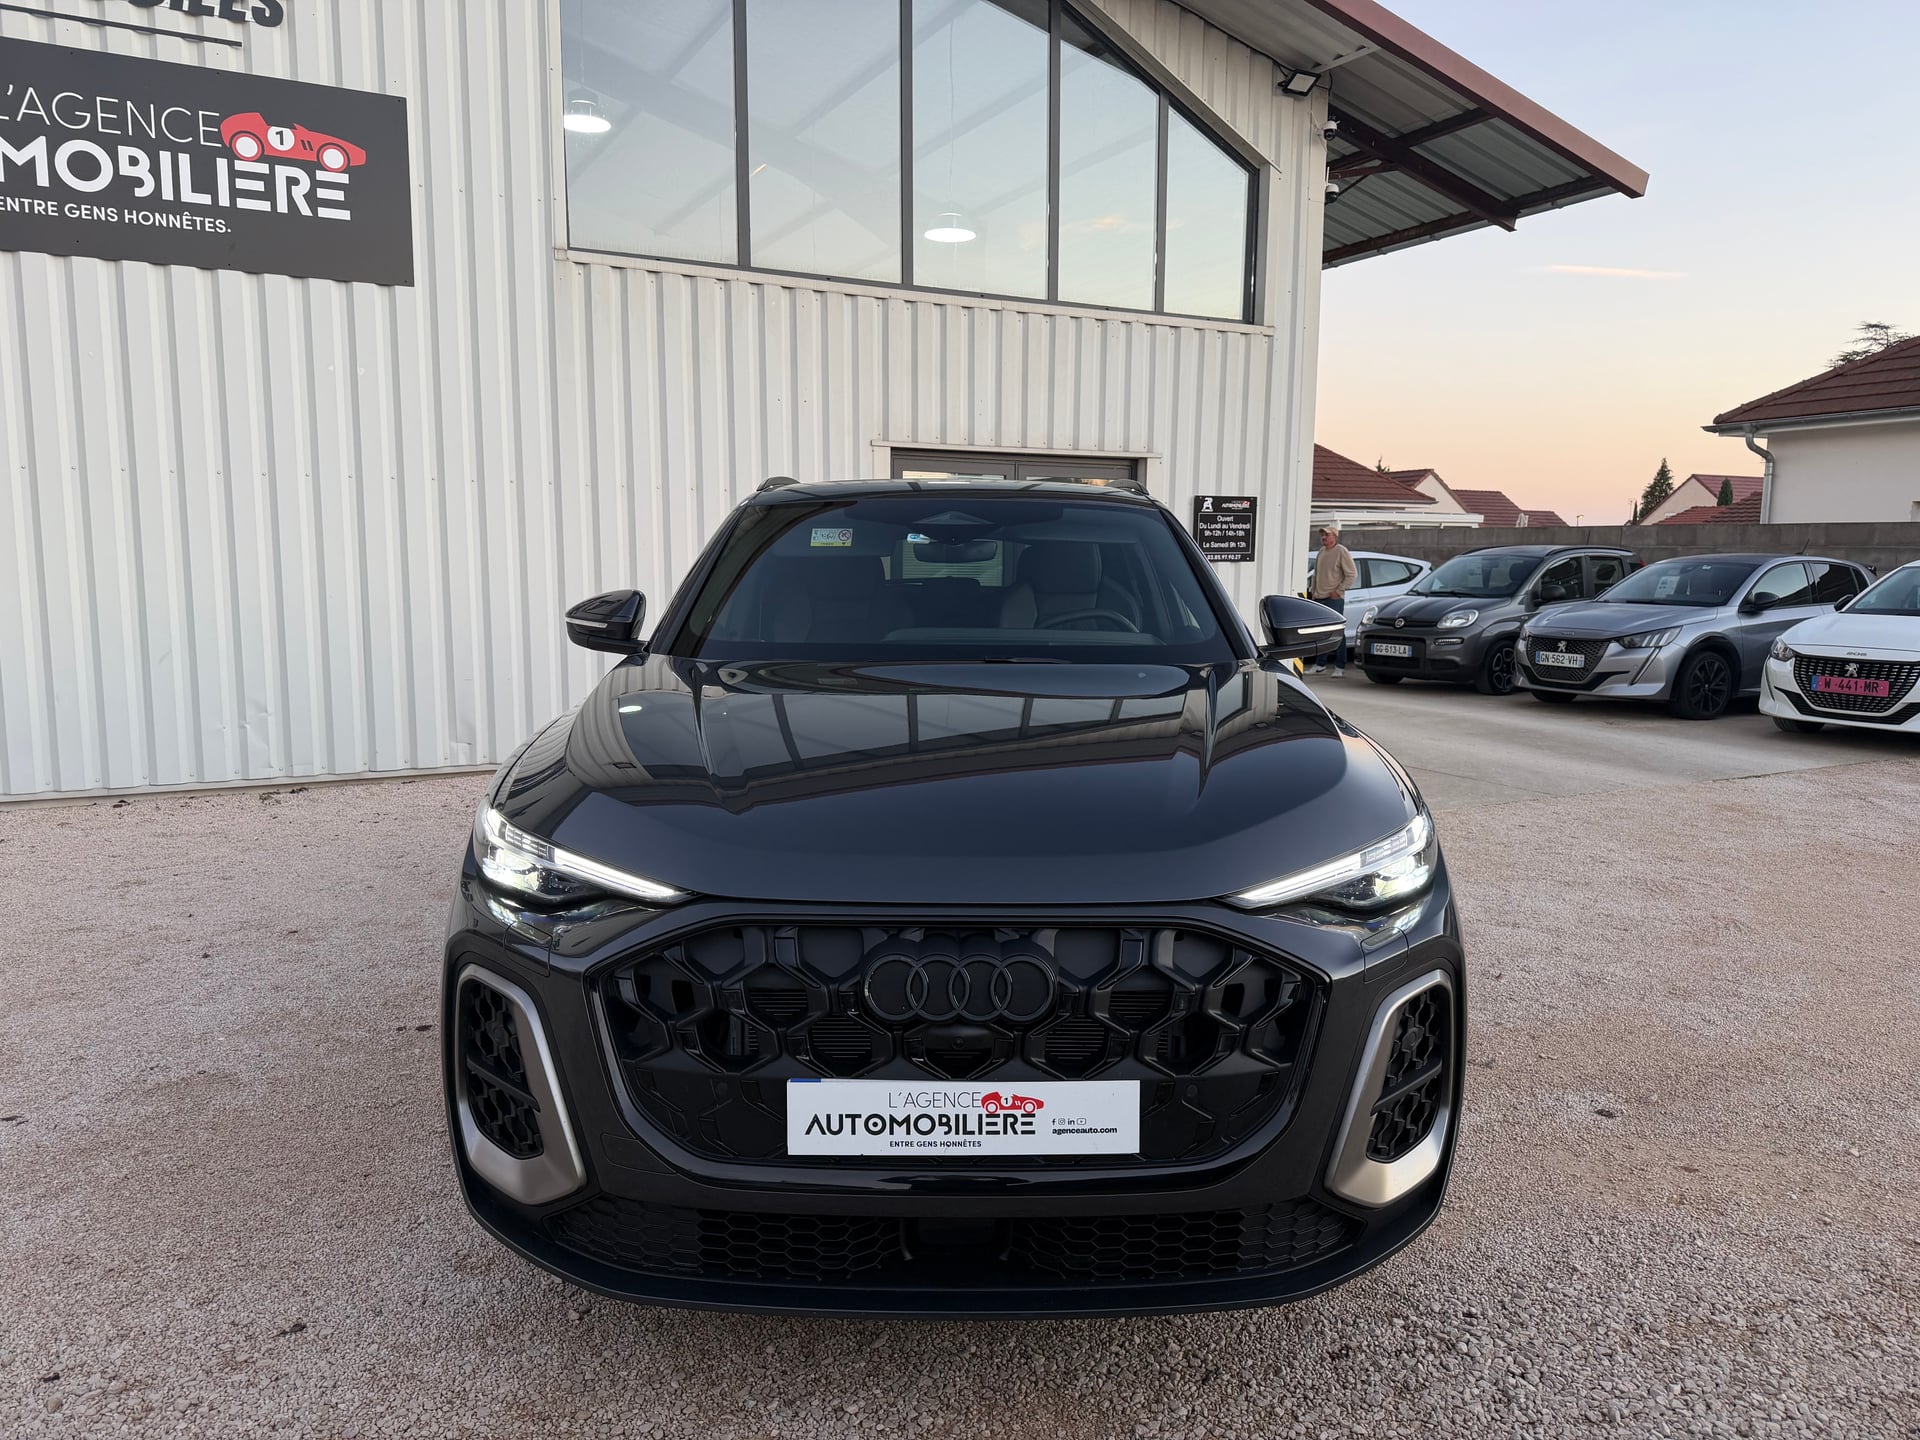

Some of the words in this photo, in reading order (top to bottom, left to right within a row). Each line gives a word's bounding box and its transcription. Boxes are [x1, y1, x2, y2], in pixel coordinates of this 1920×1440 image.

[0, 84, 222, 147] 'AGENCE
[274, 129, 285, 146] 1
[64, 203, 118, 222] GENS
[124, 209, 232, 234] HONNÊTES.
[888, 1091, 982, 1108] L'AGENCE
[1003, 1097, 1009, 1105] 1
[1051, 1127, 1118, 1135] agenceauto.com
[889, 1140, 915, 1148] ENTRE
[916, 1140, 938, 1148] GENS
[939, 1138, 982, 1148] HONNÊTES
